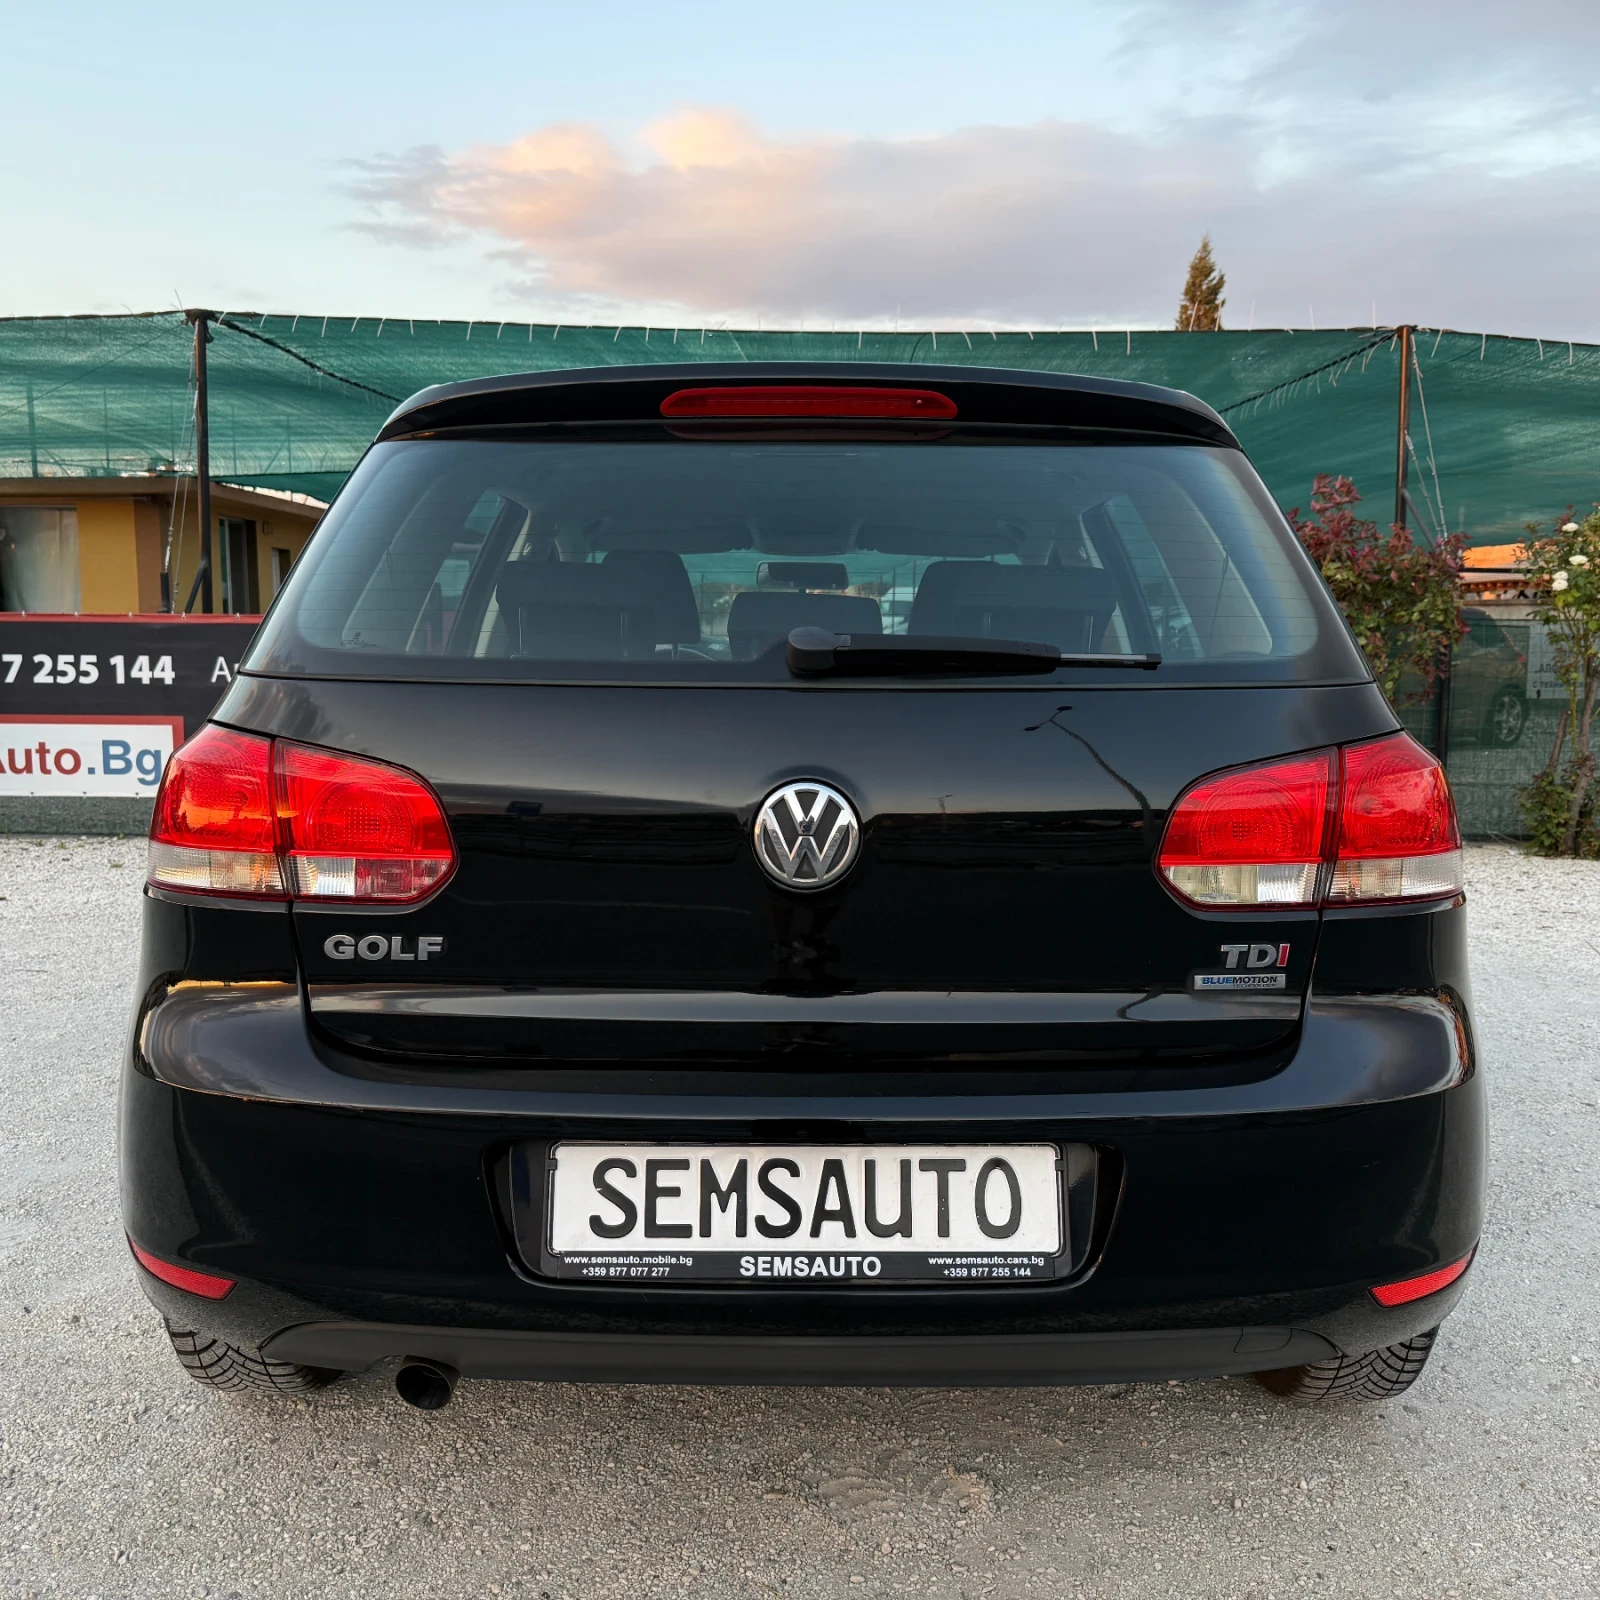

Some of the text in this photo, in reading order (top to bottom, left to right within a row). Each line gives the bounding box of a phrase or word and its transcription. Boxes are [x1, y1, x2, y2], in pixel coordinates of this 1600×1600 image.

[33, 654, 99, 684] 255
[110, 655, 175, 685] 144
[0, 740, 163, 785] uto.Bg
[324, 934, 443, 960] GOLF
[1221, 944, 1290, 968] TDI
[1202, 976, 1278, 985] BLUEMOTION
[589, 1157, 1022, 1239] SEMSAUTO
[582, 1267, 670, 1276] +359 877 077 277
[740, 1256, 881, 1276] SEMSAUTO
[928, 1256, 1044, 1266] www.semsauto.cars.bg
[943, 1268, 1031, 1277] +359 877 255 144
